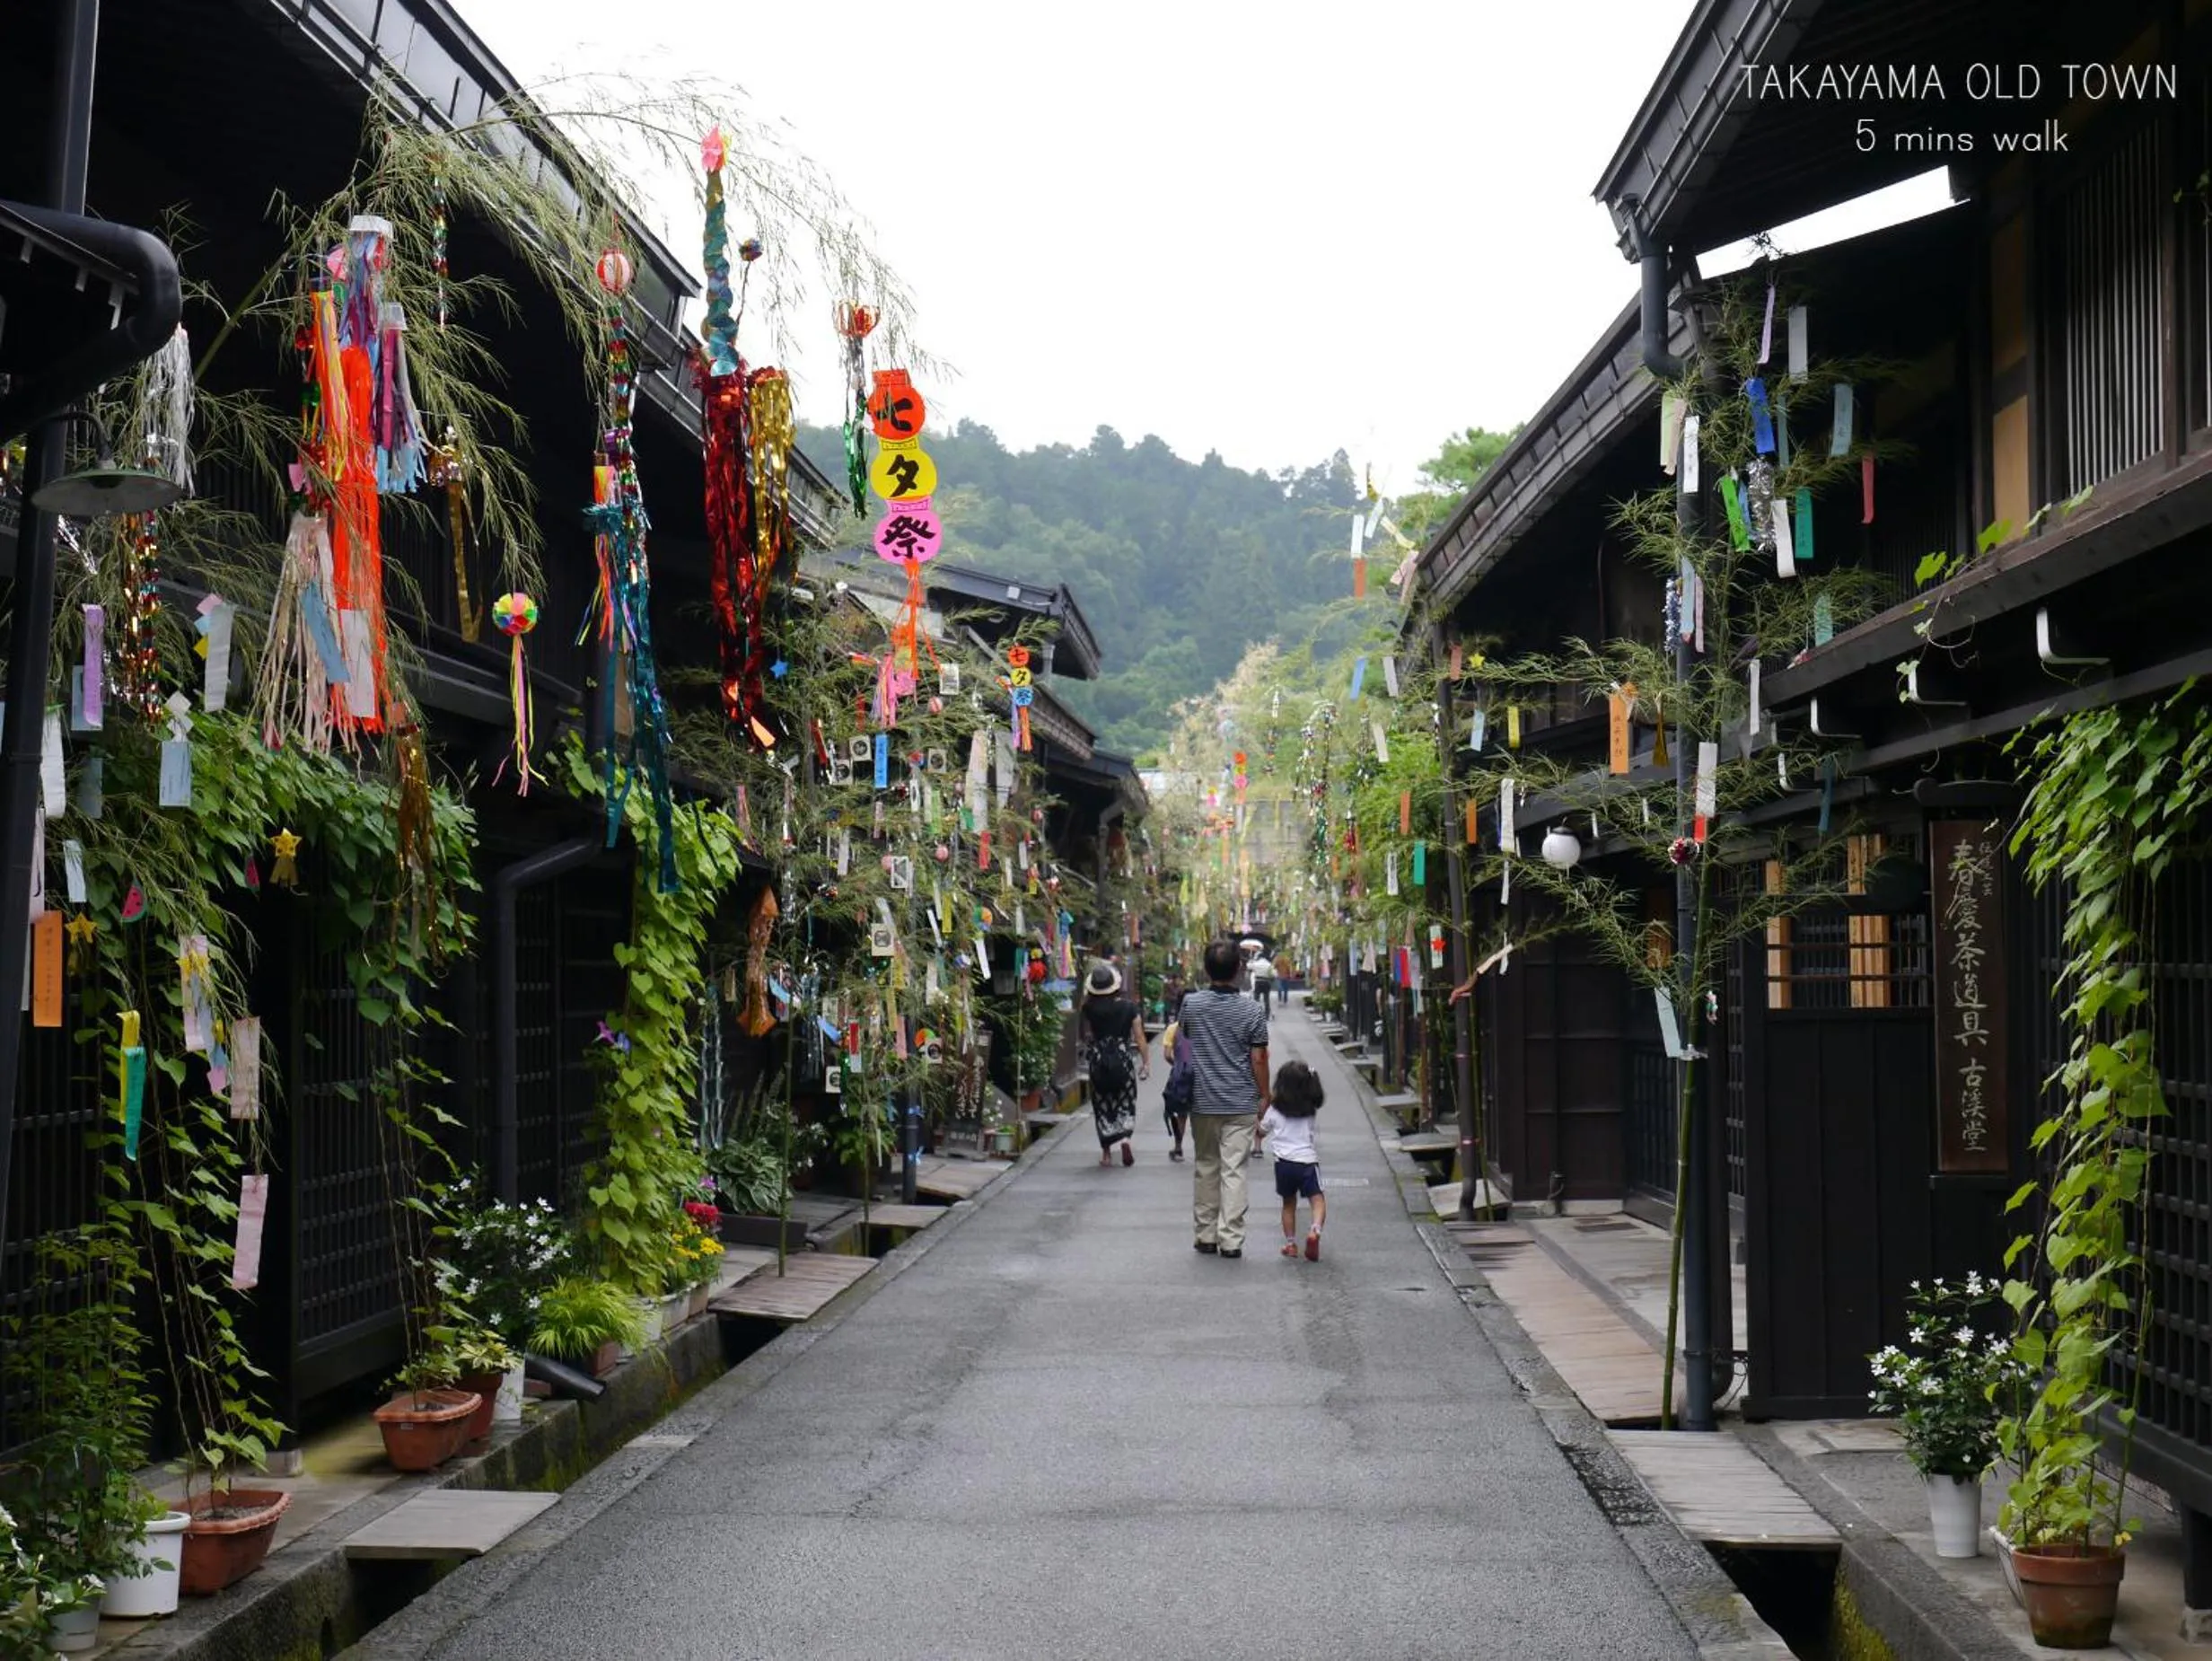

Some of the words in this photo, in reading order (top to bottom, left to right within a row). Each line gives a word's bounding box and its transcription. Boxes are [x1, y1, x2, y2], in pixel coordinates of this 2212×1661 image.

[875, 391, 936, 559] 七夕祭
[1010, 648, 1031, 705] 七夕祭
[1948, 839, 1990, 1047] 春慶茶道具
